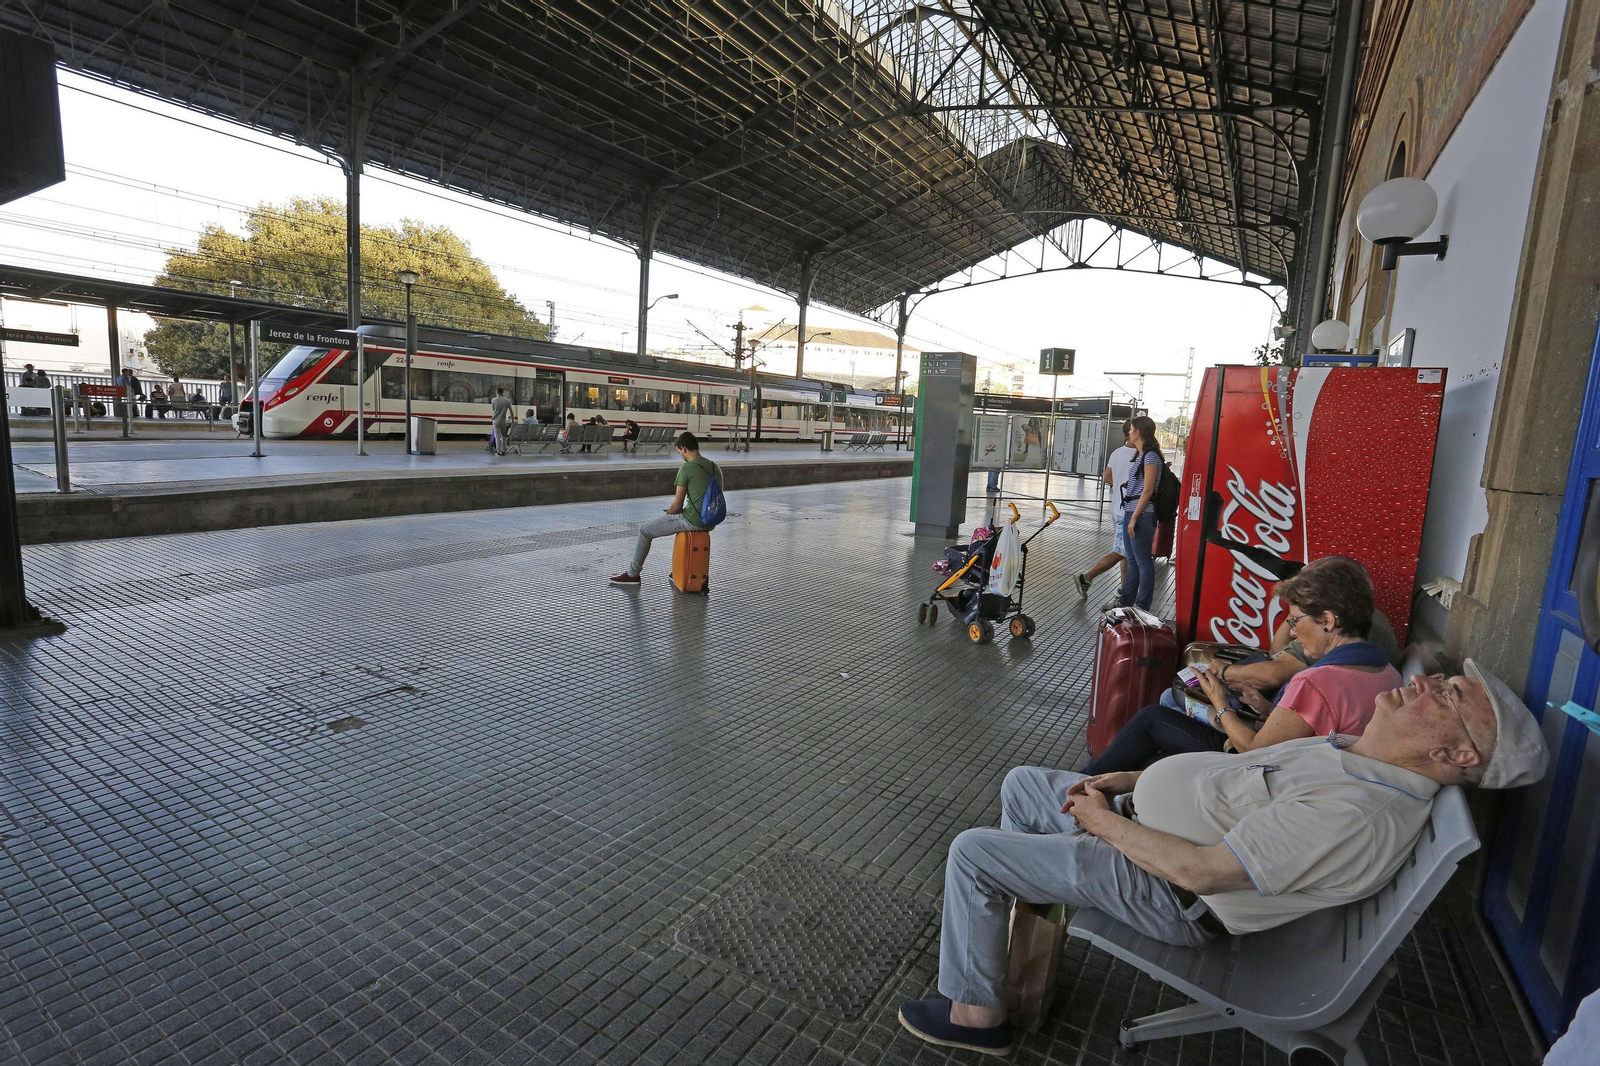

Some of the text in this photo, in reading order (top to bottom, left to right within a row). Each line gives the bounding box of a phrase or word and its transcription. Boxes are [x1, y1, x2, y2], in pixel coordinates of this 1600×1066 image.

[45, 335, 73, 343] Frontera
[268, 329, 350, 346] Jerez de la Frontera
[437, 360, 456, 369] renfe
[306, 392, 339, 404] renfe
